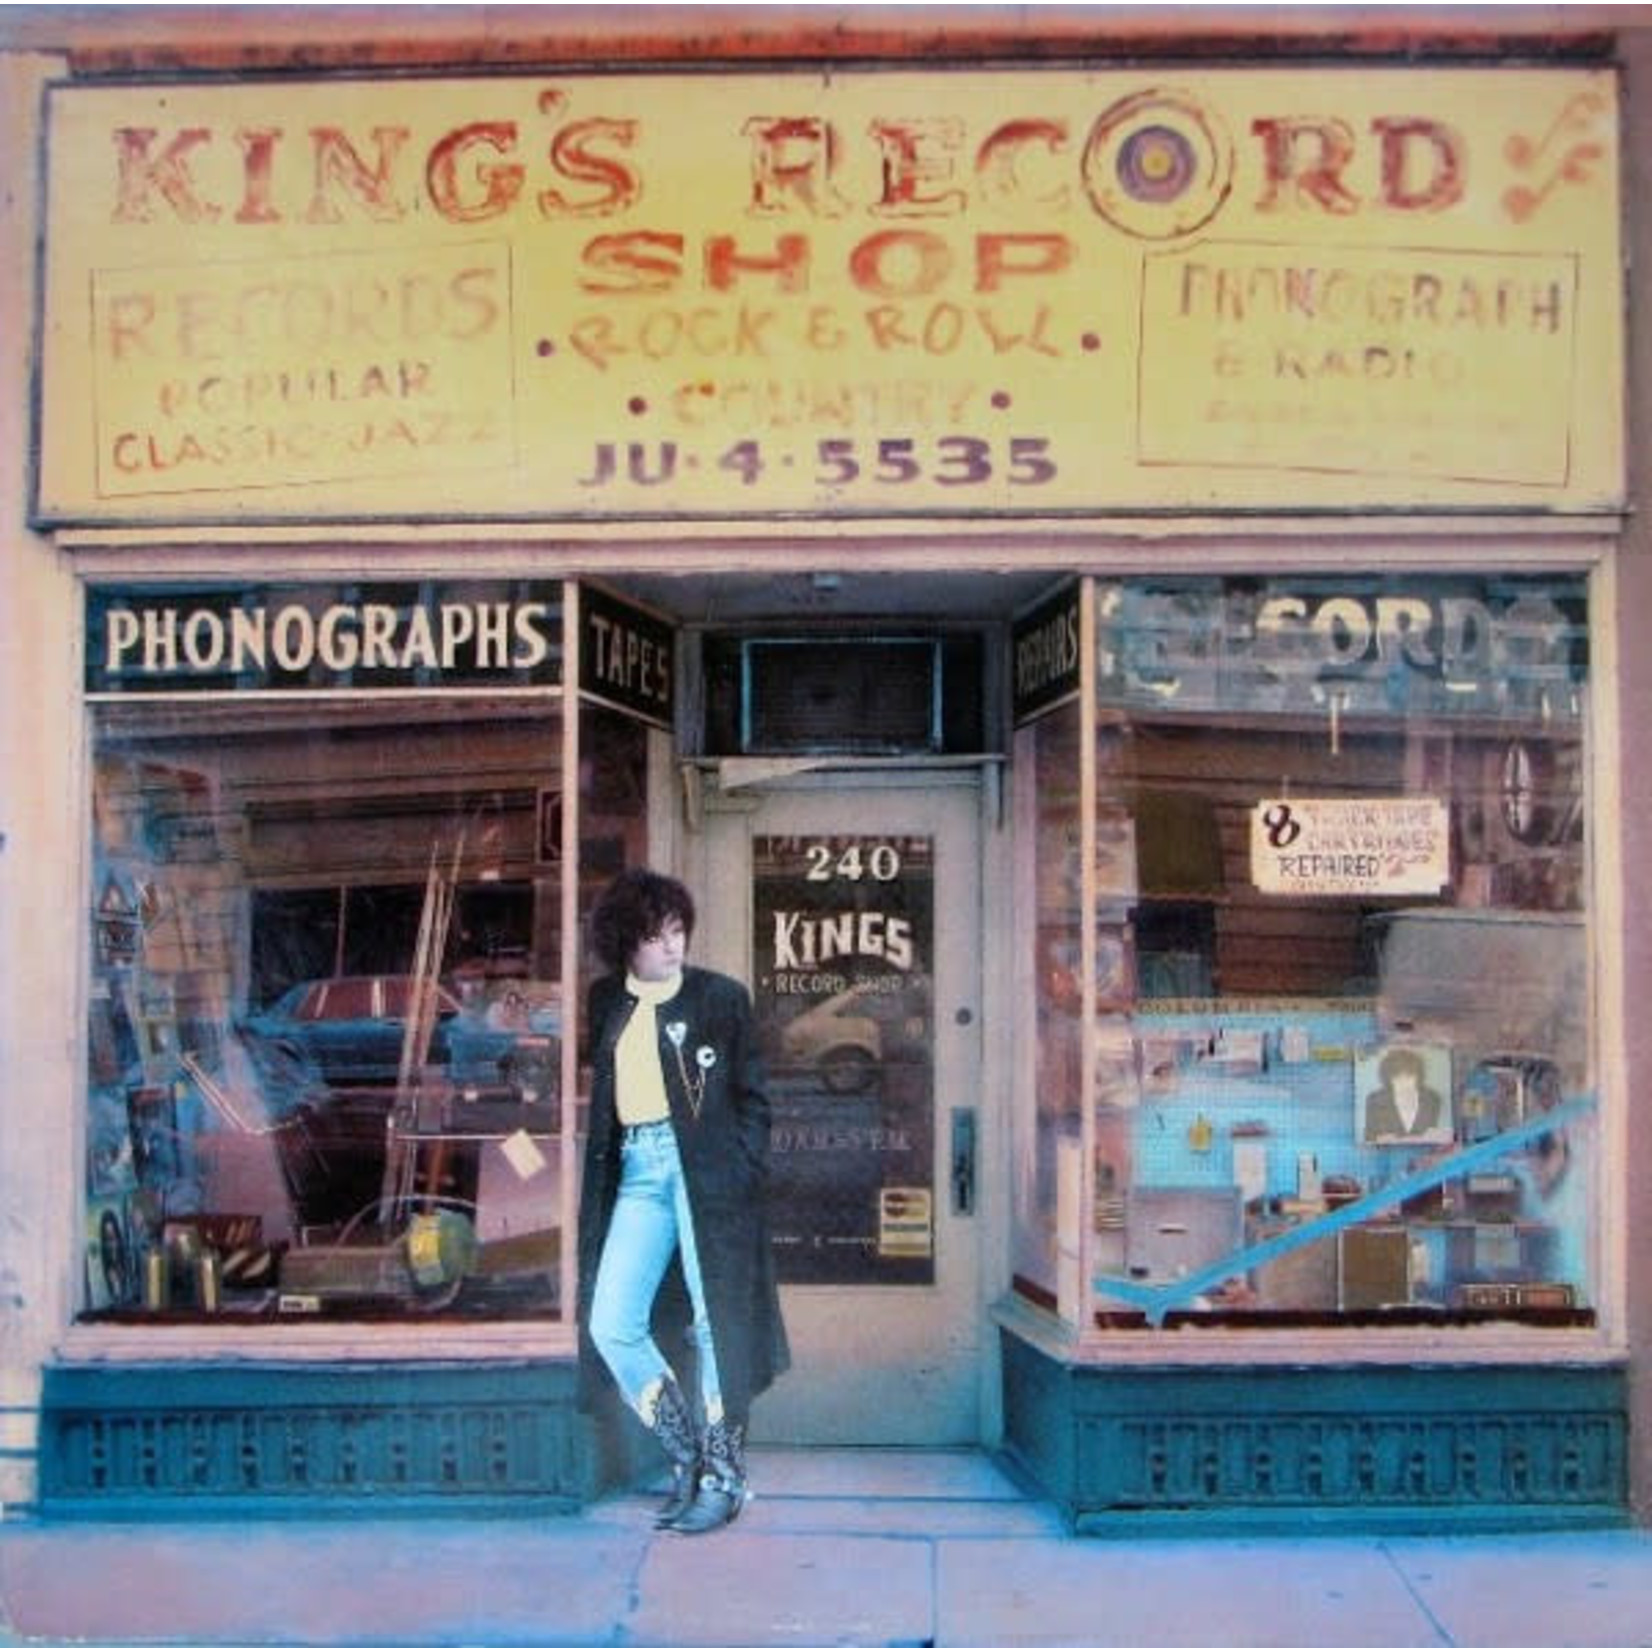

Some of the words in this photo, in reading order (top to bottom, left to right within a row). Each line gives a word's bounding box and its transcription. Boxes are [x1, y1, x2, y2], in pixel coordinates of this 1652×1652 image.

[110, 90, 640, 226] KING'S
[742, 88, 1466, 240] RECORD
[577, 229, 1078, 296] SHOP
[568, 306, 774, 370] ROCK
[105, 603, 548, 673] PHONOGRAPHS
[589, 612, 669, 702] TAPES
[1262, 804, 1301, 848] 8
[806, 845, 899, 882] 240
[1276, 854, 1381, 878] REPAIRED
[775, 973, 846, 993] RECORD
